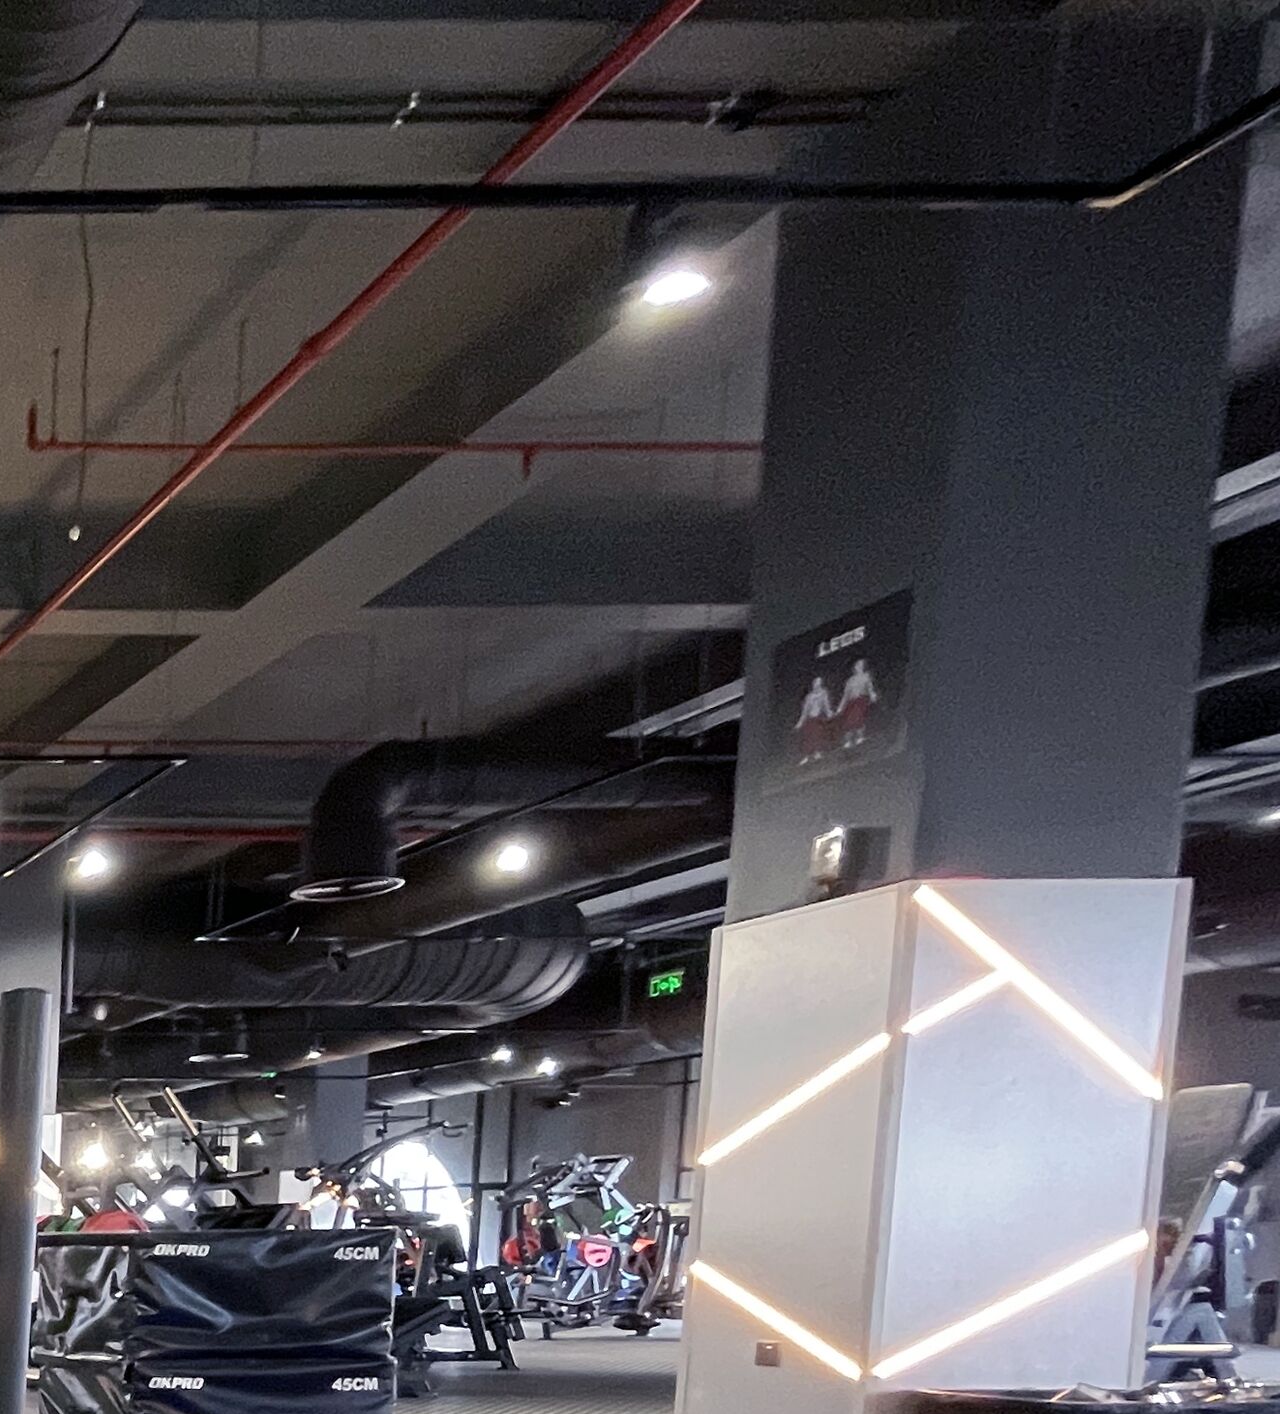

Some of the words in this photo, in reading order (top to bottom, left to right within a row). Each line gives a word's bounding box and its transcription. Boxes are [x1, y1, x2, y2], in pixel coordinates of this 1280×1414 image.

[153, 1243, 210, 1258] OKPRO
[334, 1246, 380, 1260] 45CM
[148, 1376, 205, 1390] OKPRO
[331, 1377, 379, 1392] 45CM
